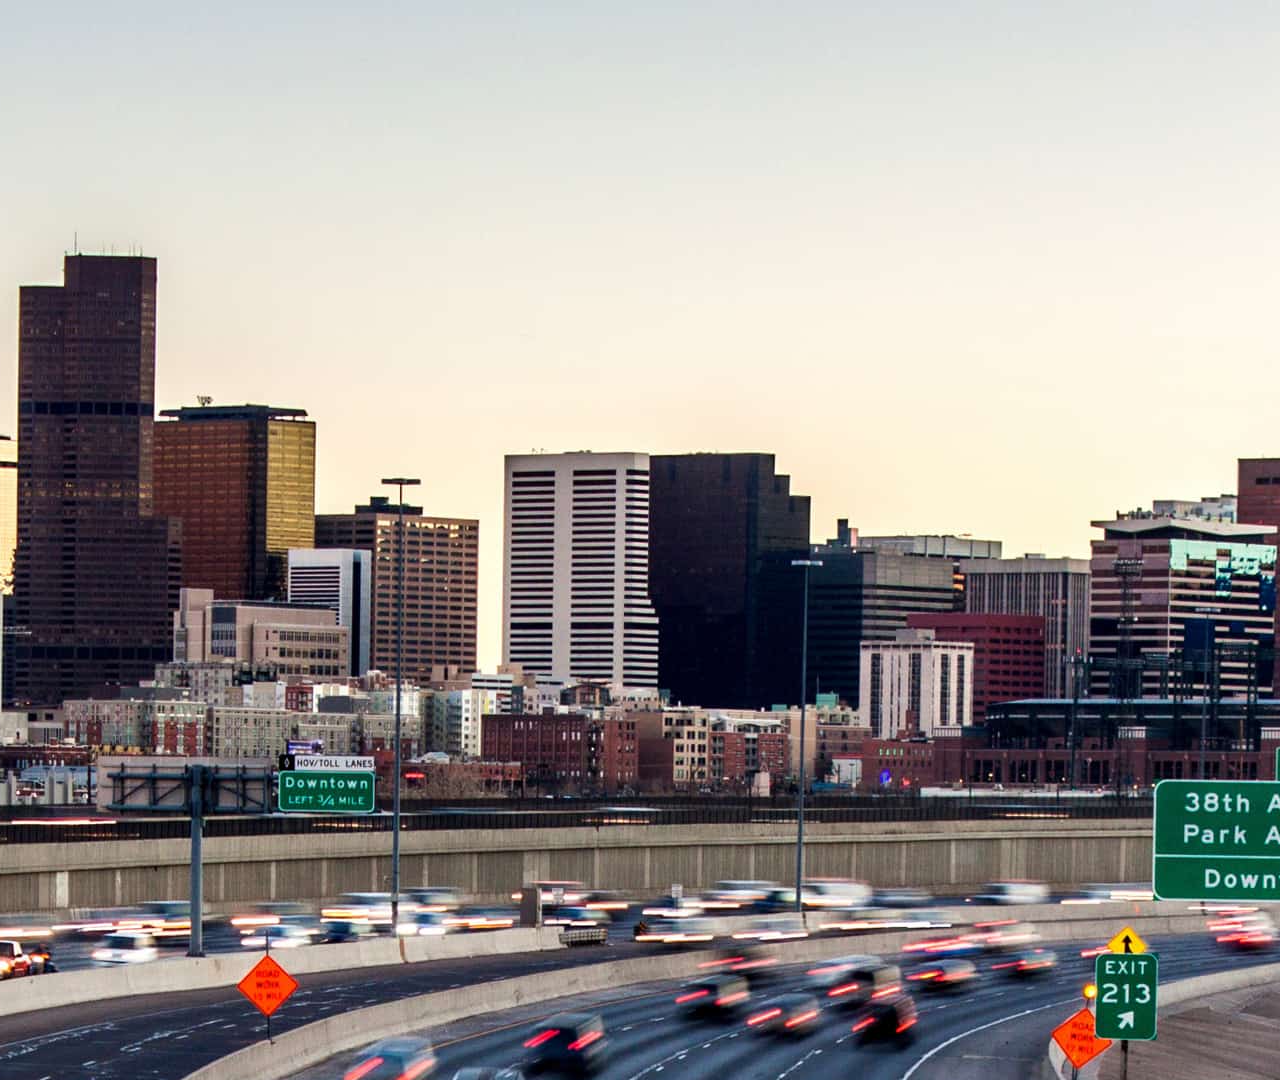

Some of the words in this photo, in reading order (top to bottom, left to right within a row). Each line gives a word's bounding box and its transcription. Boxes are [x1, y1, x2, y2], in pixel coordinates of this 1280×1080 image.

[297, 760, 340, 768] HOV/TOLL
[346, 760, 372, 768] LANES
[286, 777, 368, 789] Downtown
[289, 796, 312, 804] LEFT
[339, 797, 364, 805] MILE
[1185, 793, 1250, 813] 38th
[1183, 825, 1248, 844] Park
[1105, 961, 1147, 976] EXIT
[1102, 984, 1151, 1004] 213
